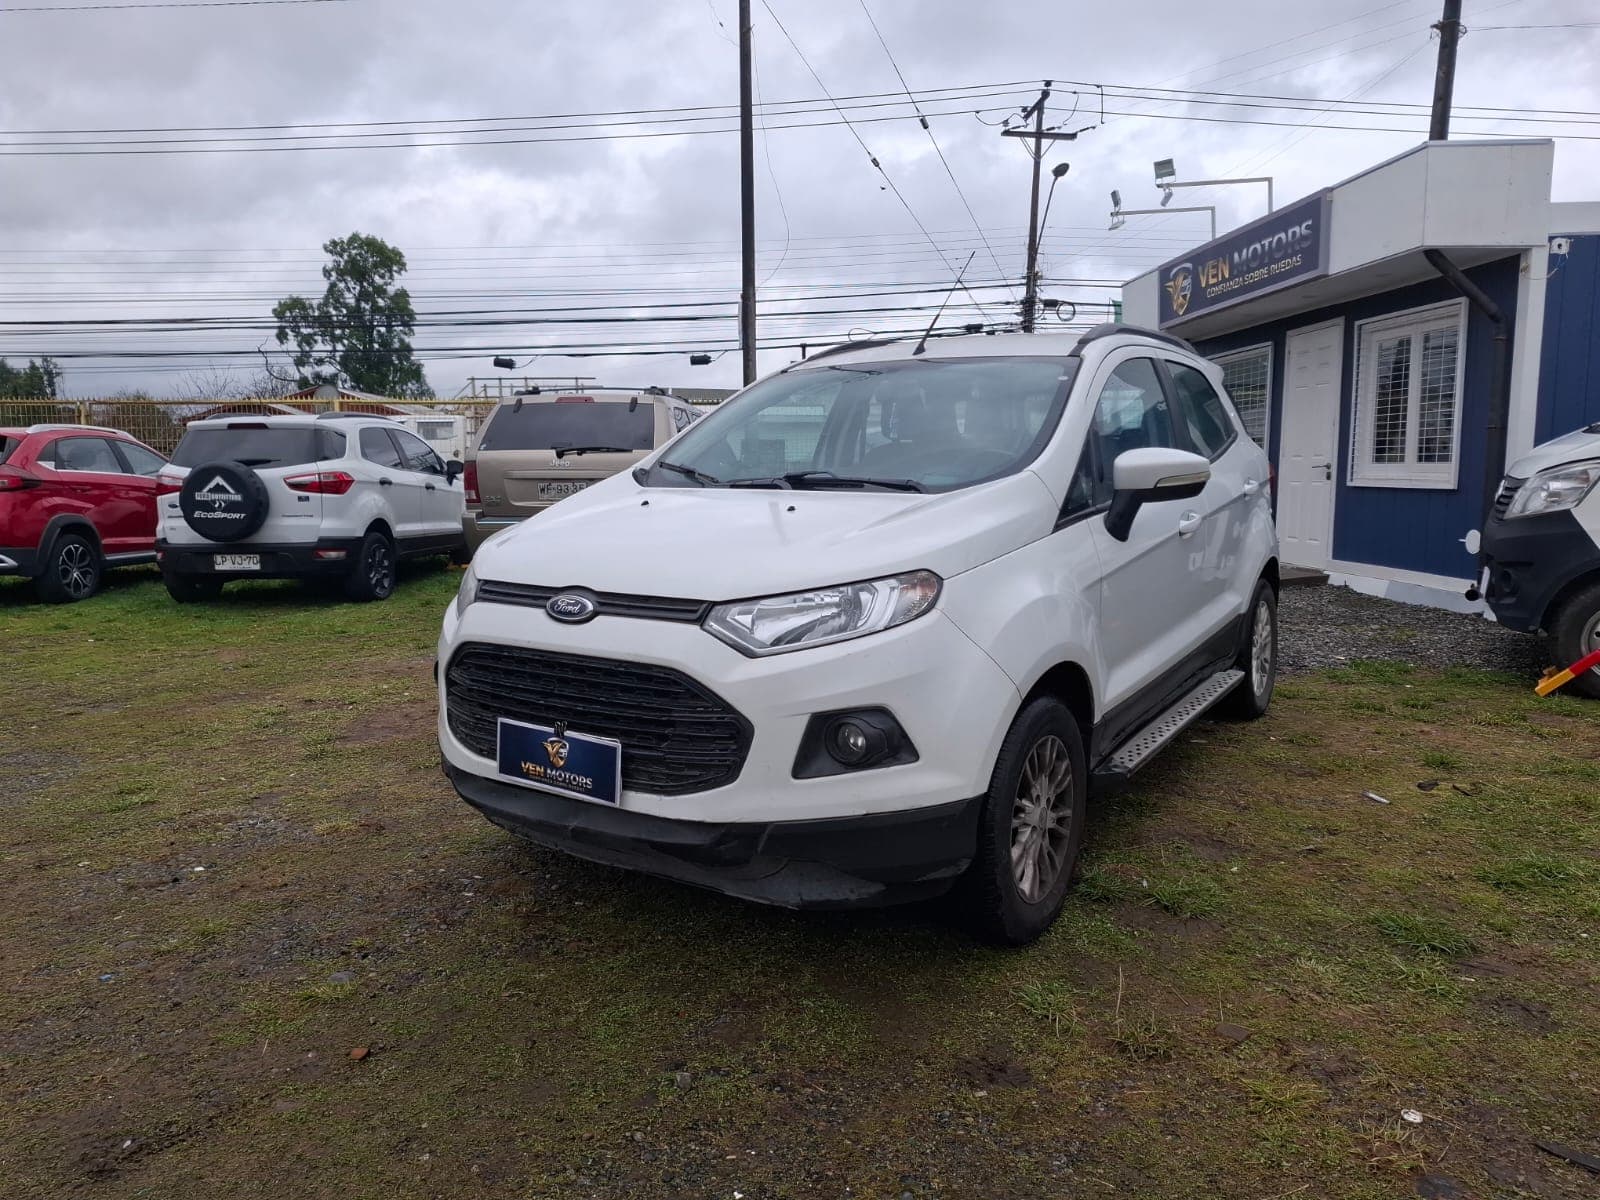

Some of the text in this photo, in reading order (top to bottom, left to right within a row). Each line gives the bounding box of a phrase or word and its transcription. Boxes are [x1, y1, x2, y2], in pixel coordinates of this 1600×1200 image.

[1198, 219, 1313, 288] VEN MOTORS
[1206, 254, 1302, 298] CONFIANZA SOBRE RUEDAS
[554, 598, 581, 613] Ford
[521, 760, 545, 777] VEN
[546, 767, 593, 789] MOTORS
